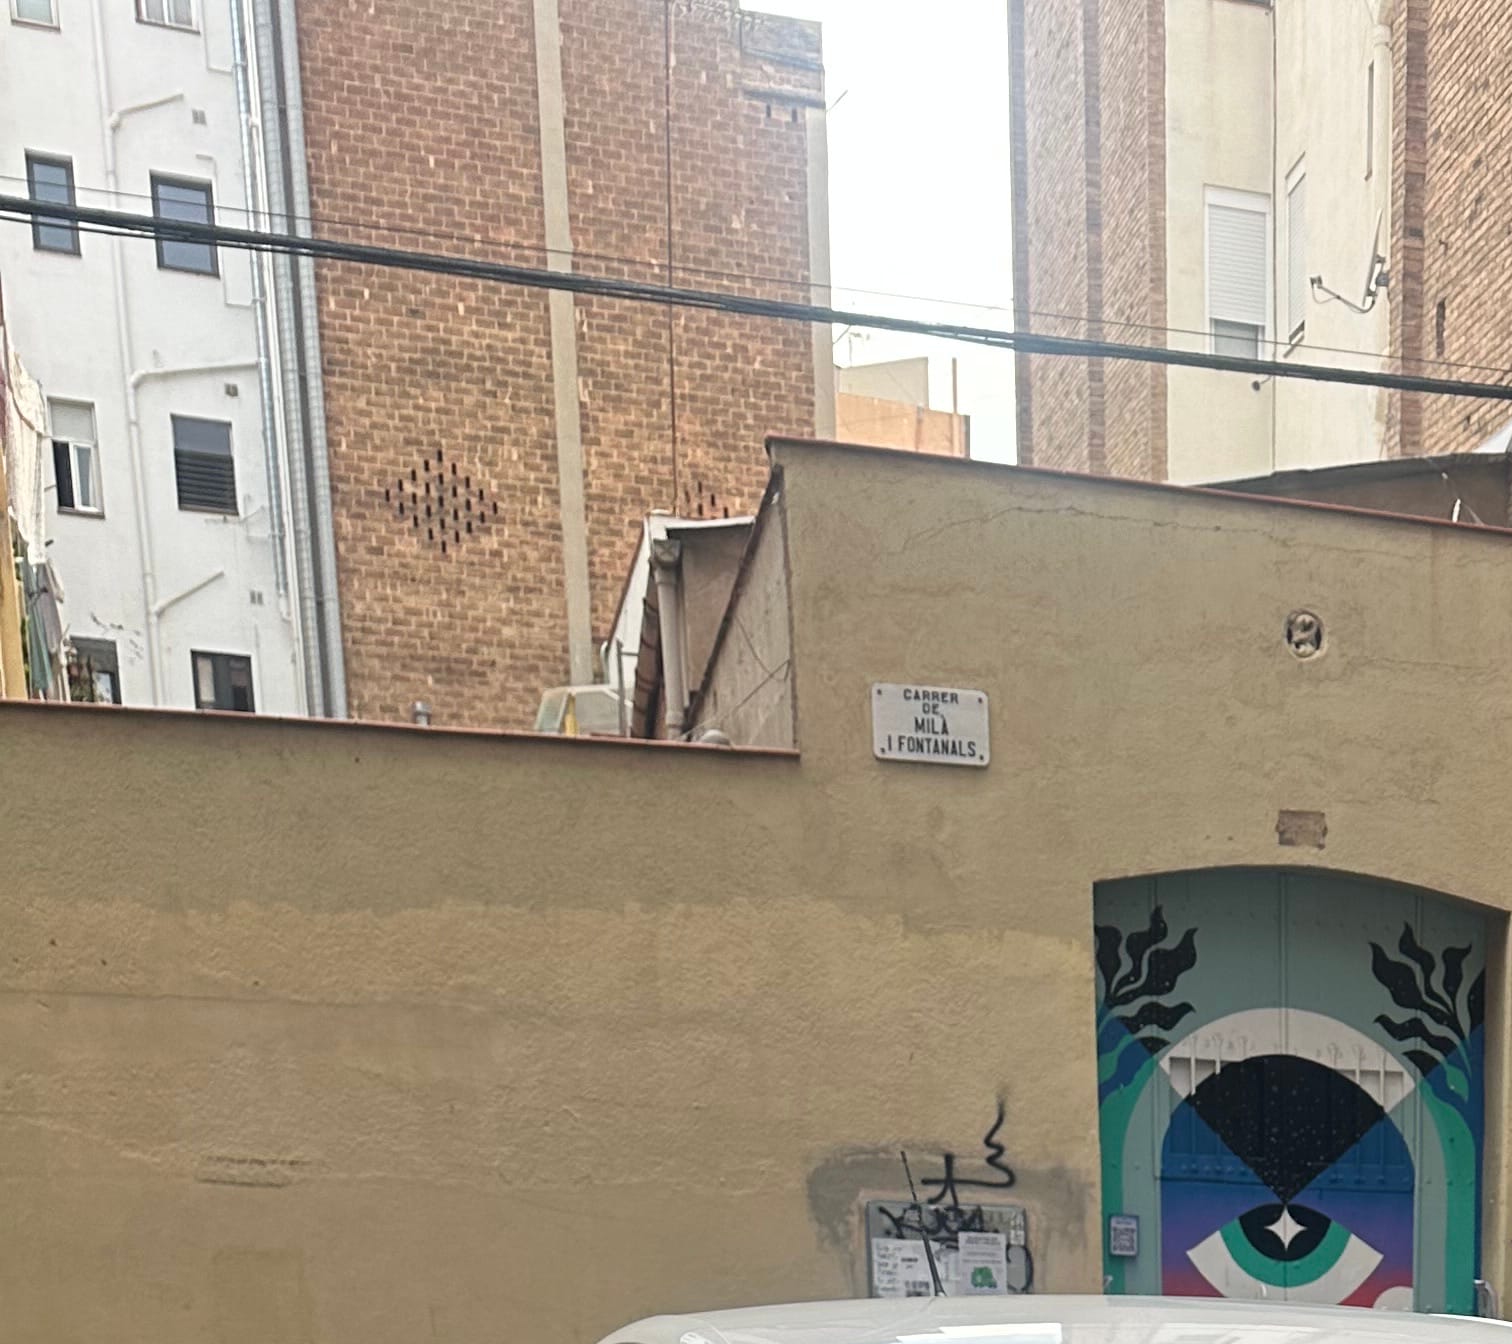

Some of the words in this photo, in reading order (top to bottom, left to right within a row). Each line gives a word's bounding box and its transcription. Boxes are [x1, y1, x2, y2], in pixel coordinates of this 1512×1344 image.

[903, 688, 959, 704] CARRER
[922, 702, 940, 715] DE
[914, 714, 950, 736] MILÀ
[887, 734, 893, 752] I
[898, 735, 977, 758] FONTANALS
